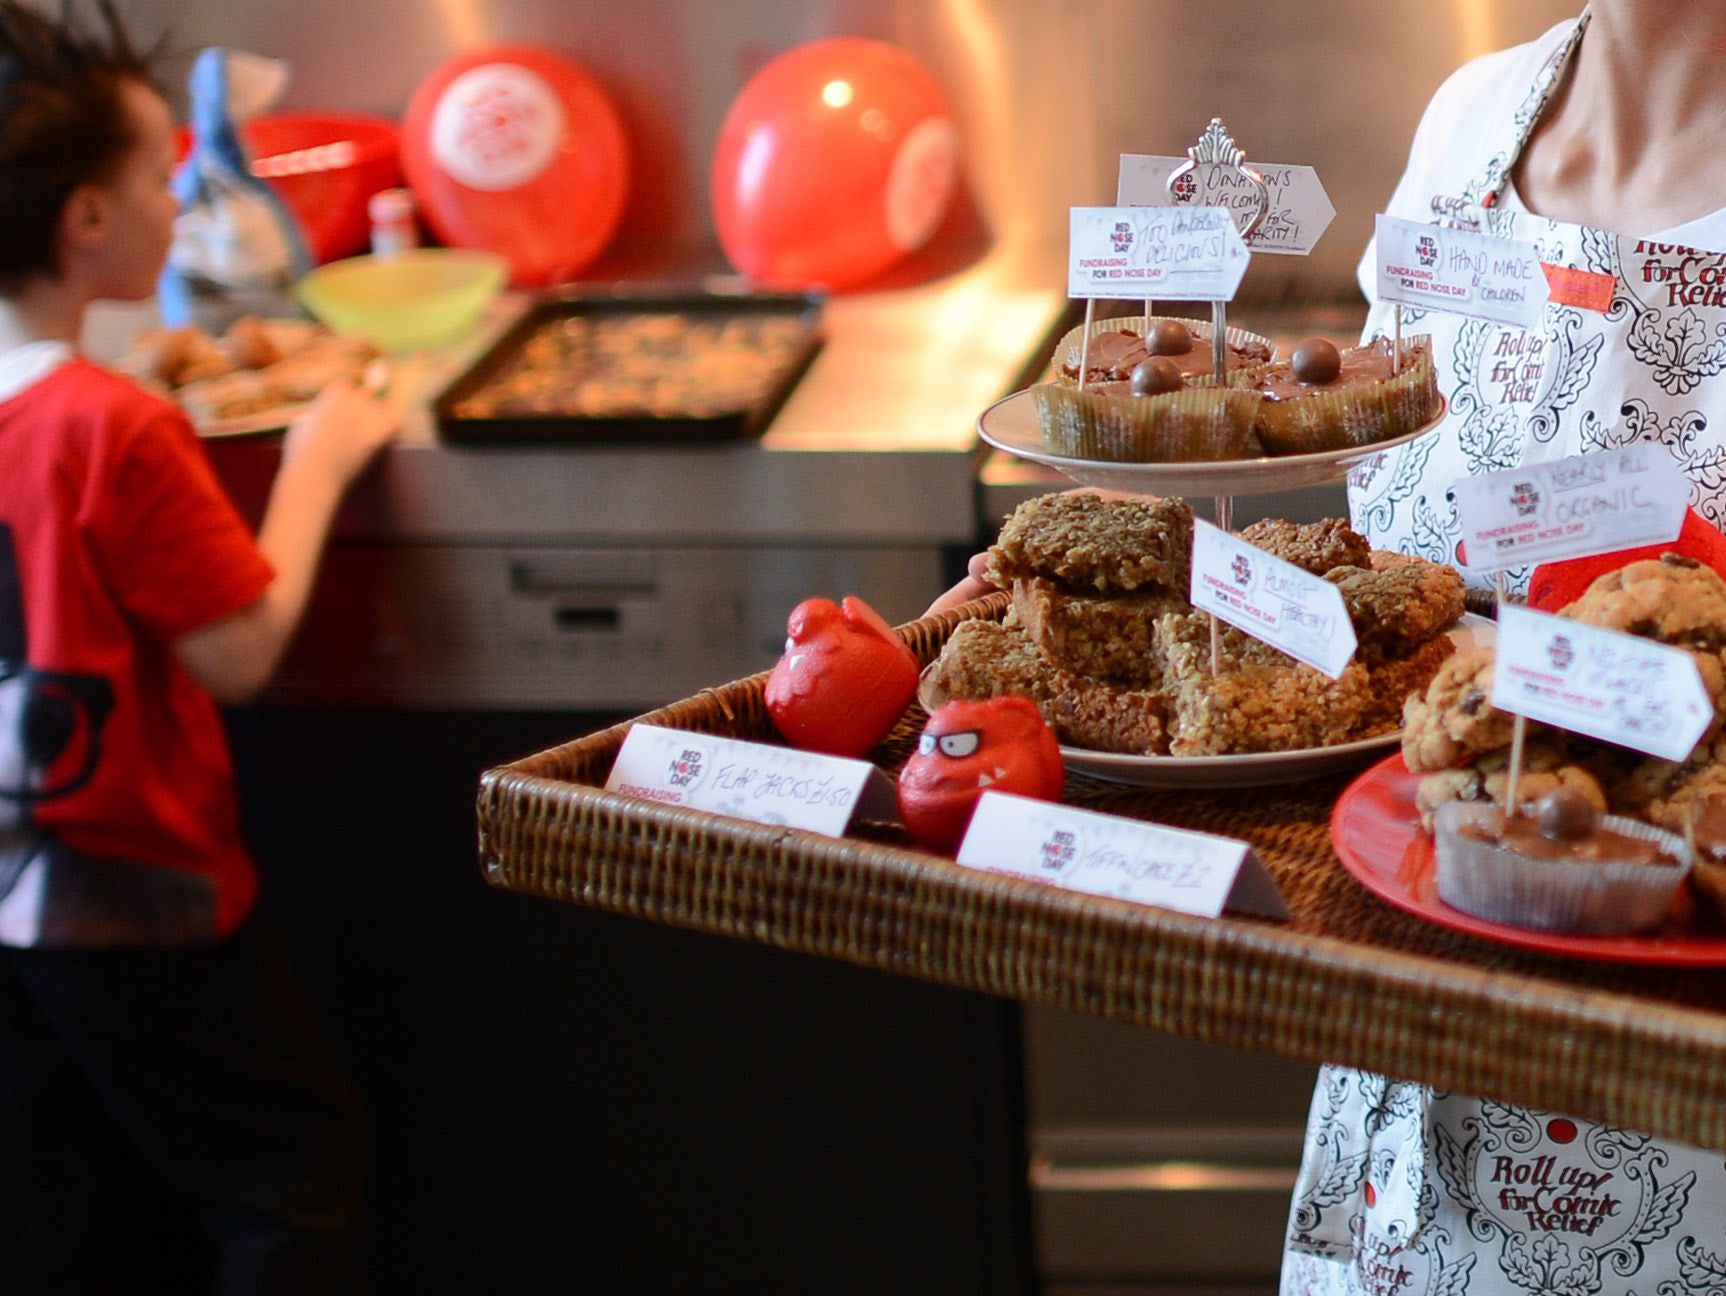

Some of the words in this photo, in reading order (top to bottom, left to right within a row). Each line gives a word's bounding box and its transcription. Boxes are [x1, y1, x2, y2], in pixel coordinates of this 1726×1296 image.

[1115, 222, 1130, 232] RED
[1114, 243, 1130, 253] DAY
[1420, 236, 1435, 247] RED
[1415, 245, 1438, 258] NOSE
[1079, 257, 1128, 268] FUNDRAISING
[1420, 256, 1435, 267] DAY
[1449, 246, 1487, 275] HAND
[1493, 258, 1533, 280] MADE
[1093, 269, 1107, 278] FOR
[1108, 269, 1122, 278] RED
[1124, 268, 1145, 278] NOSE
[1147, 268, 1162, 278] DAY
[1386, 265, 1434, 280] FUNDRAISING
[1401, 278, 1414, 288] FOR
[1415, 280, 1429, 290] RED
[1430, 283, 1450, 294] NOSE
[1452, 286, 1466, 296] DAY
[680, 749, 702, 762] RED
[668, 761, 703, 778] NOSE
[669, 773, 693, 786] DAY
[617, 783, 683, 803] FUNDRAISING
[1490, 1155, 1558, 1186] Roll
[1558, 1166, 1614, 1197] up!
[1497, 1188, 1535, 1211] for
[1533, 1185, 1623, 1217] Comic
[1523, 1210, 1605, 1237] Relief
